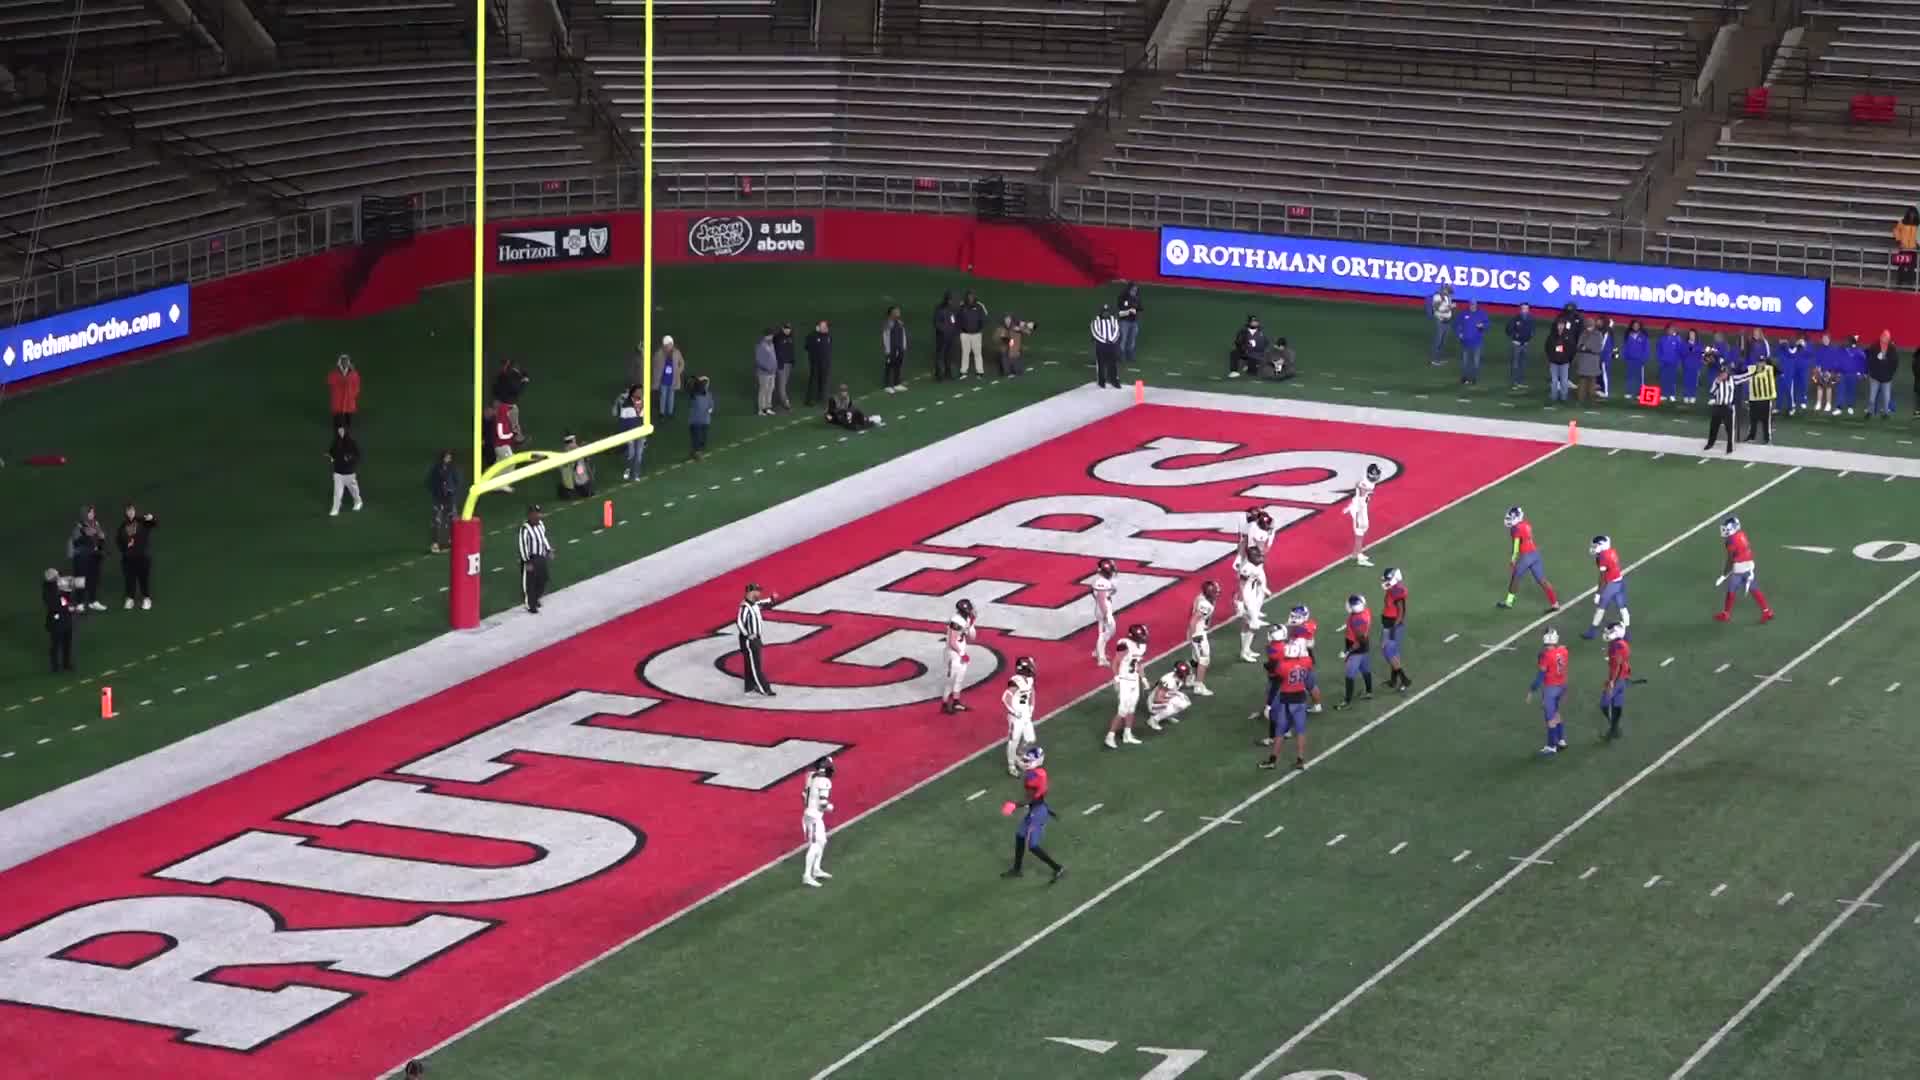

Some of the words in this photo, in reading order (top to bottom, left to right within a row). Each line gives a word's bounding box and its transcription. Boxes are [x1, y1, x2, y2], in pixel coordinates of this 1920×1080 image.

[760, 223, 770, 234] a
[775, 219, 802, 234] sub
[499, 244, 557, 261] Horizon
[757, 237, 805, 251] above
[1192, 244, 1326, 274] ROTHMAN
[1331, 255, 1532, 291] ORTHOPAEDICS
[1570, 275, 1782, 313] RothmanOrtho.com
[23, 311, 161, 363] RothmanOrtho.com
[0, 436, 1402, 1051] RUTGERS
